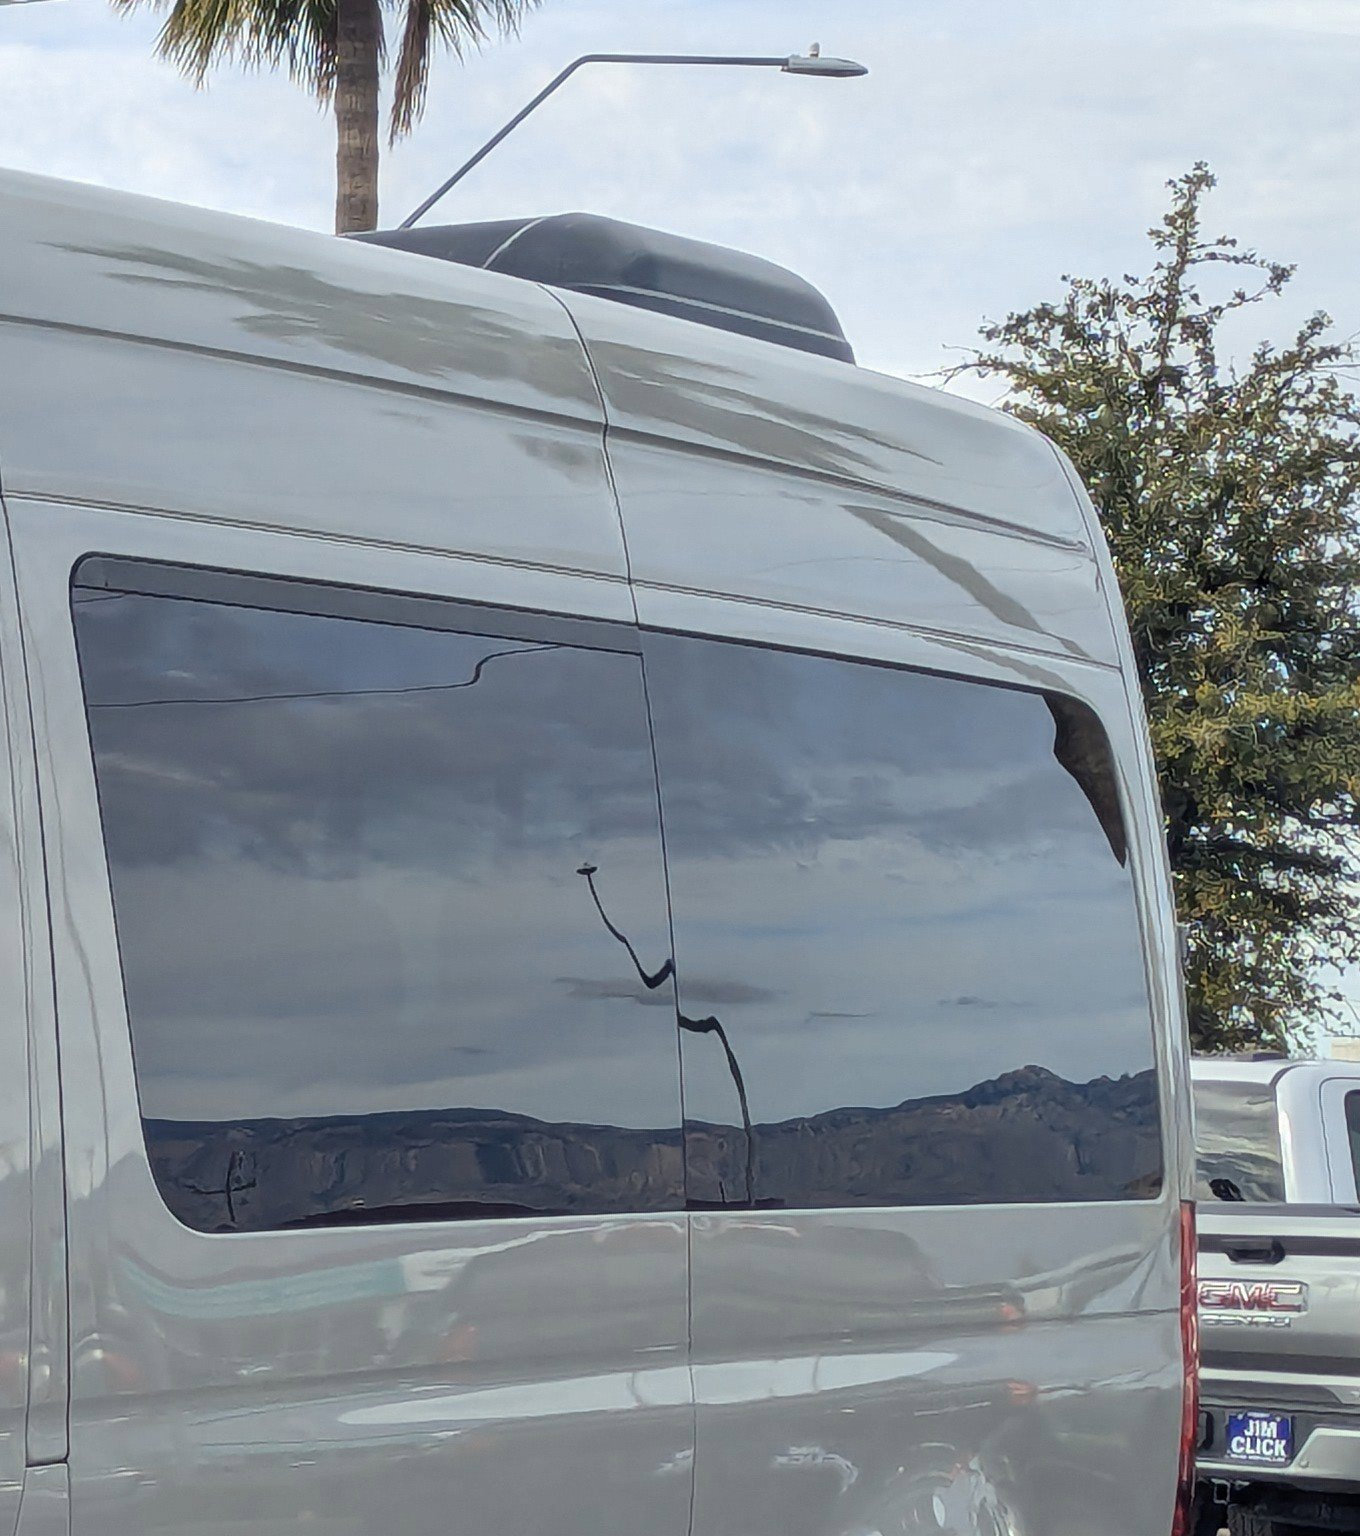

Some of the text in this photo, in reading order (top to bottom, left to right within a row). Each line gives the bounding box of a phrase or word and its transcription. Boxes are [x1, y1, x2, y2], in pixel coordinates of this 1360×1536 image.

[1198, 1282, 1302, 1312] GMC
[1244, 1419, 1279, 1438] JIM
[1230, 1436, 1287, 1456] CLICK
